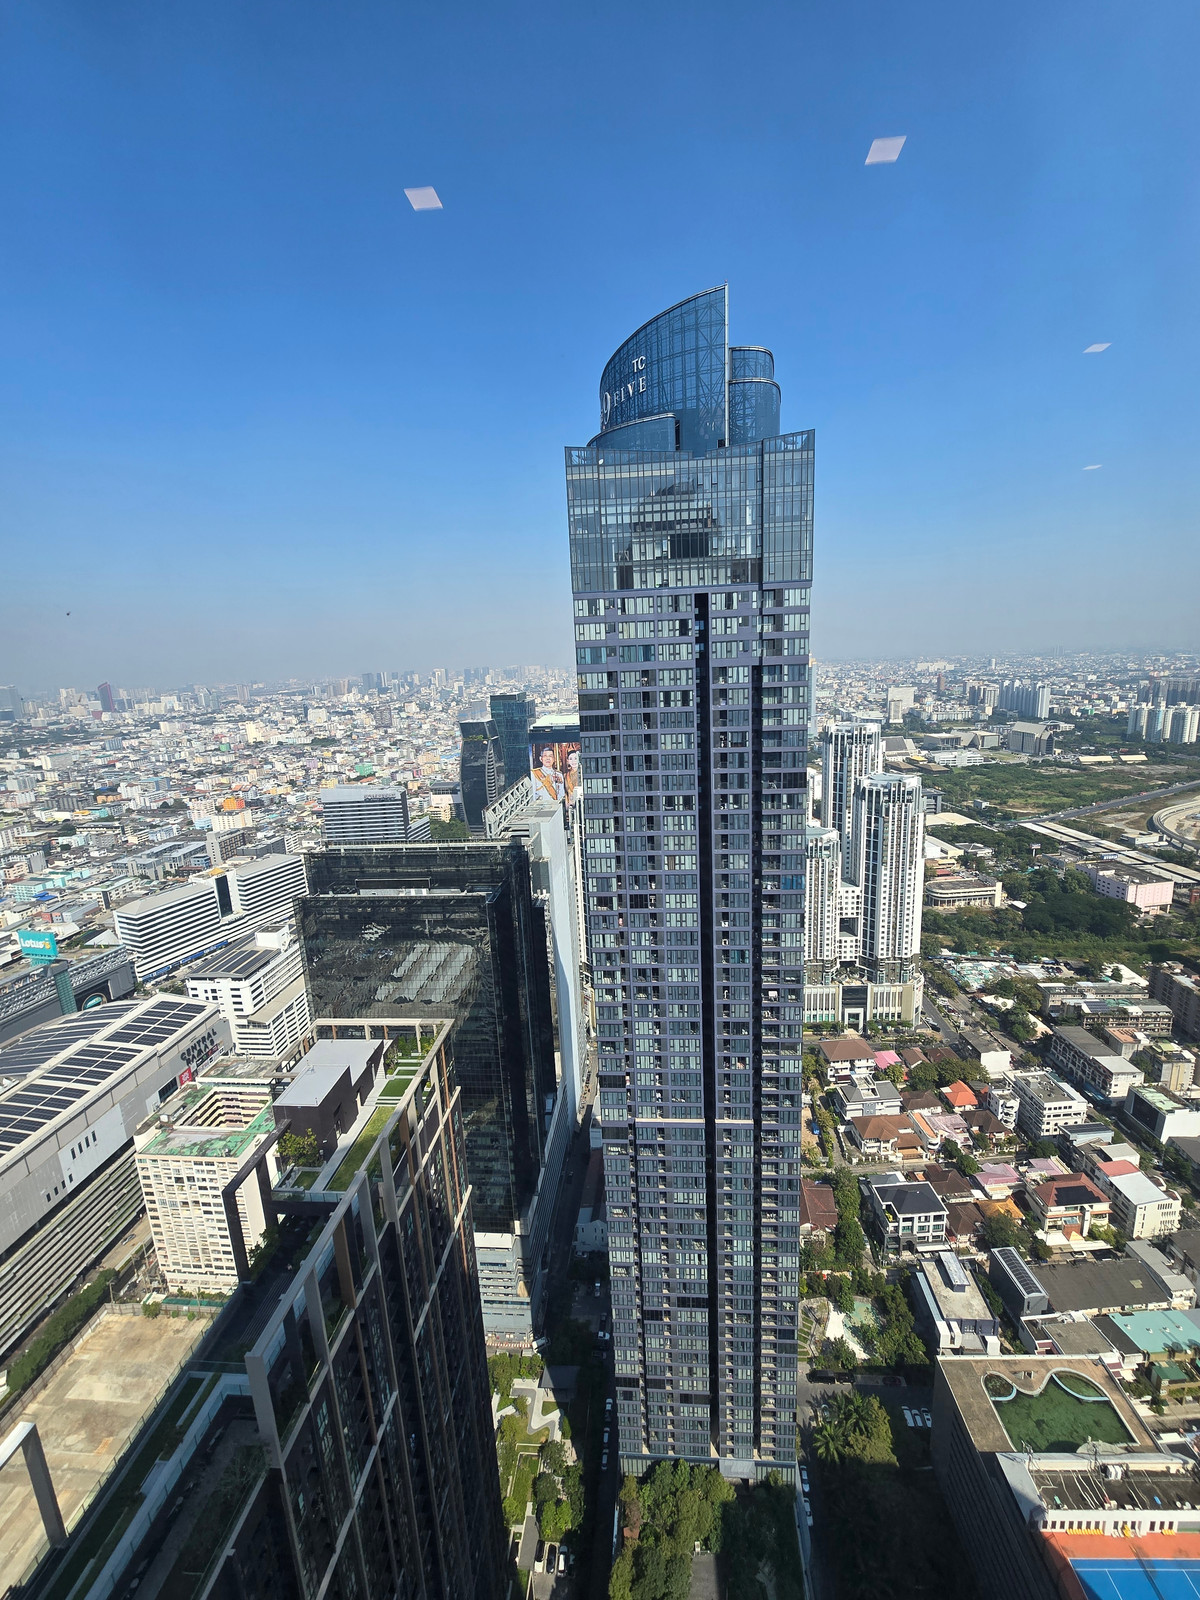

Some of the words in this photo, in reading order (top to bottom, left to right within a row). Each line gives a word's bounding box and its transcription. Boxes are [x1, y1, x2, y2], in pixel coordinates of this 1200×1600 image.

[632, 355, 646, 373] TC
[20, 938, 51, 950] Lotus's
[180, 1028, 217, 1062] CENTRAL
